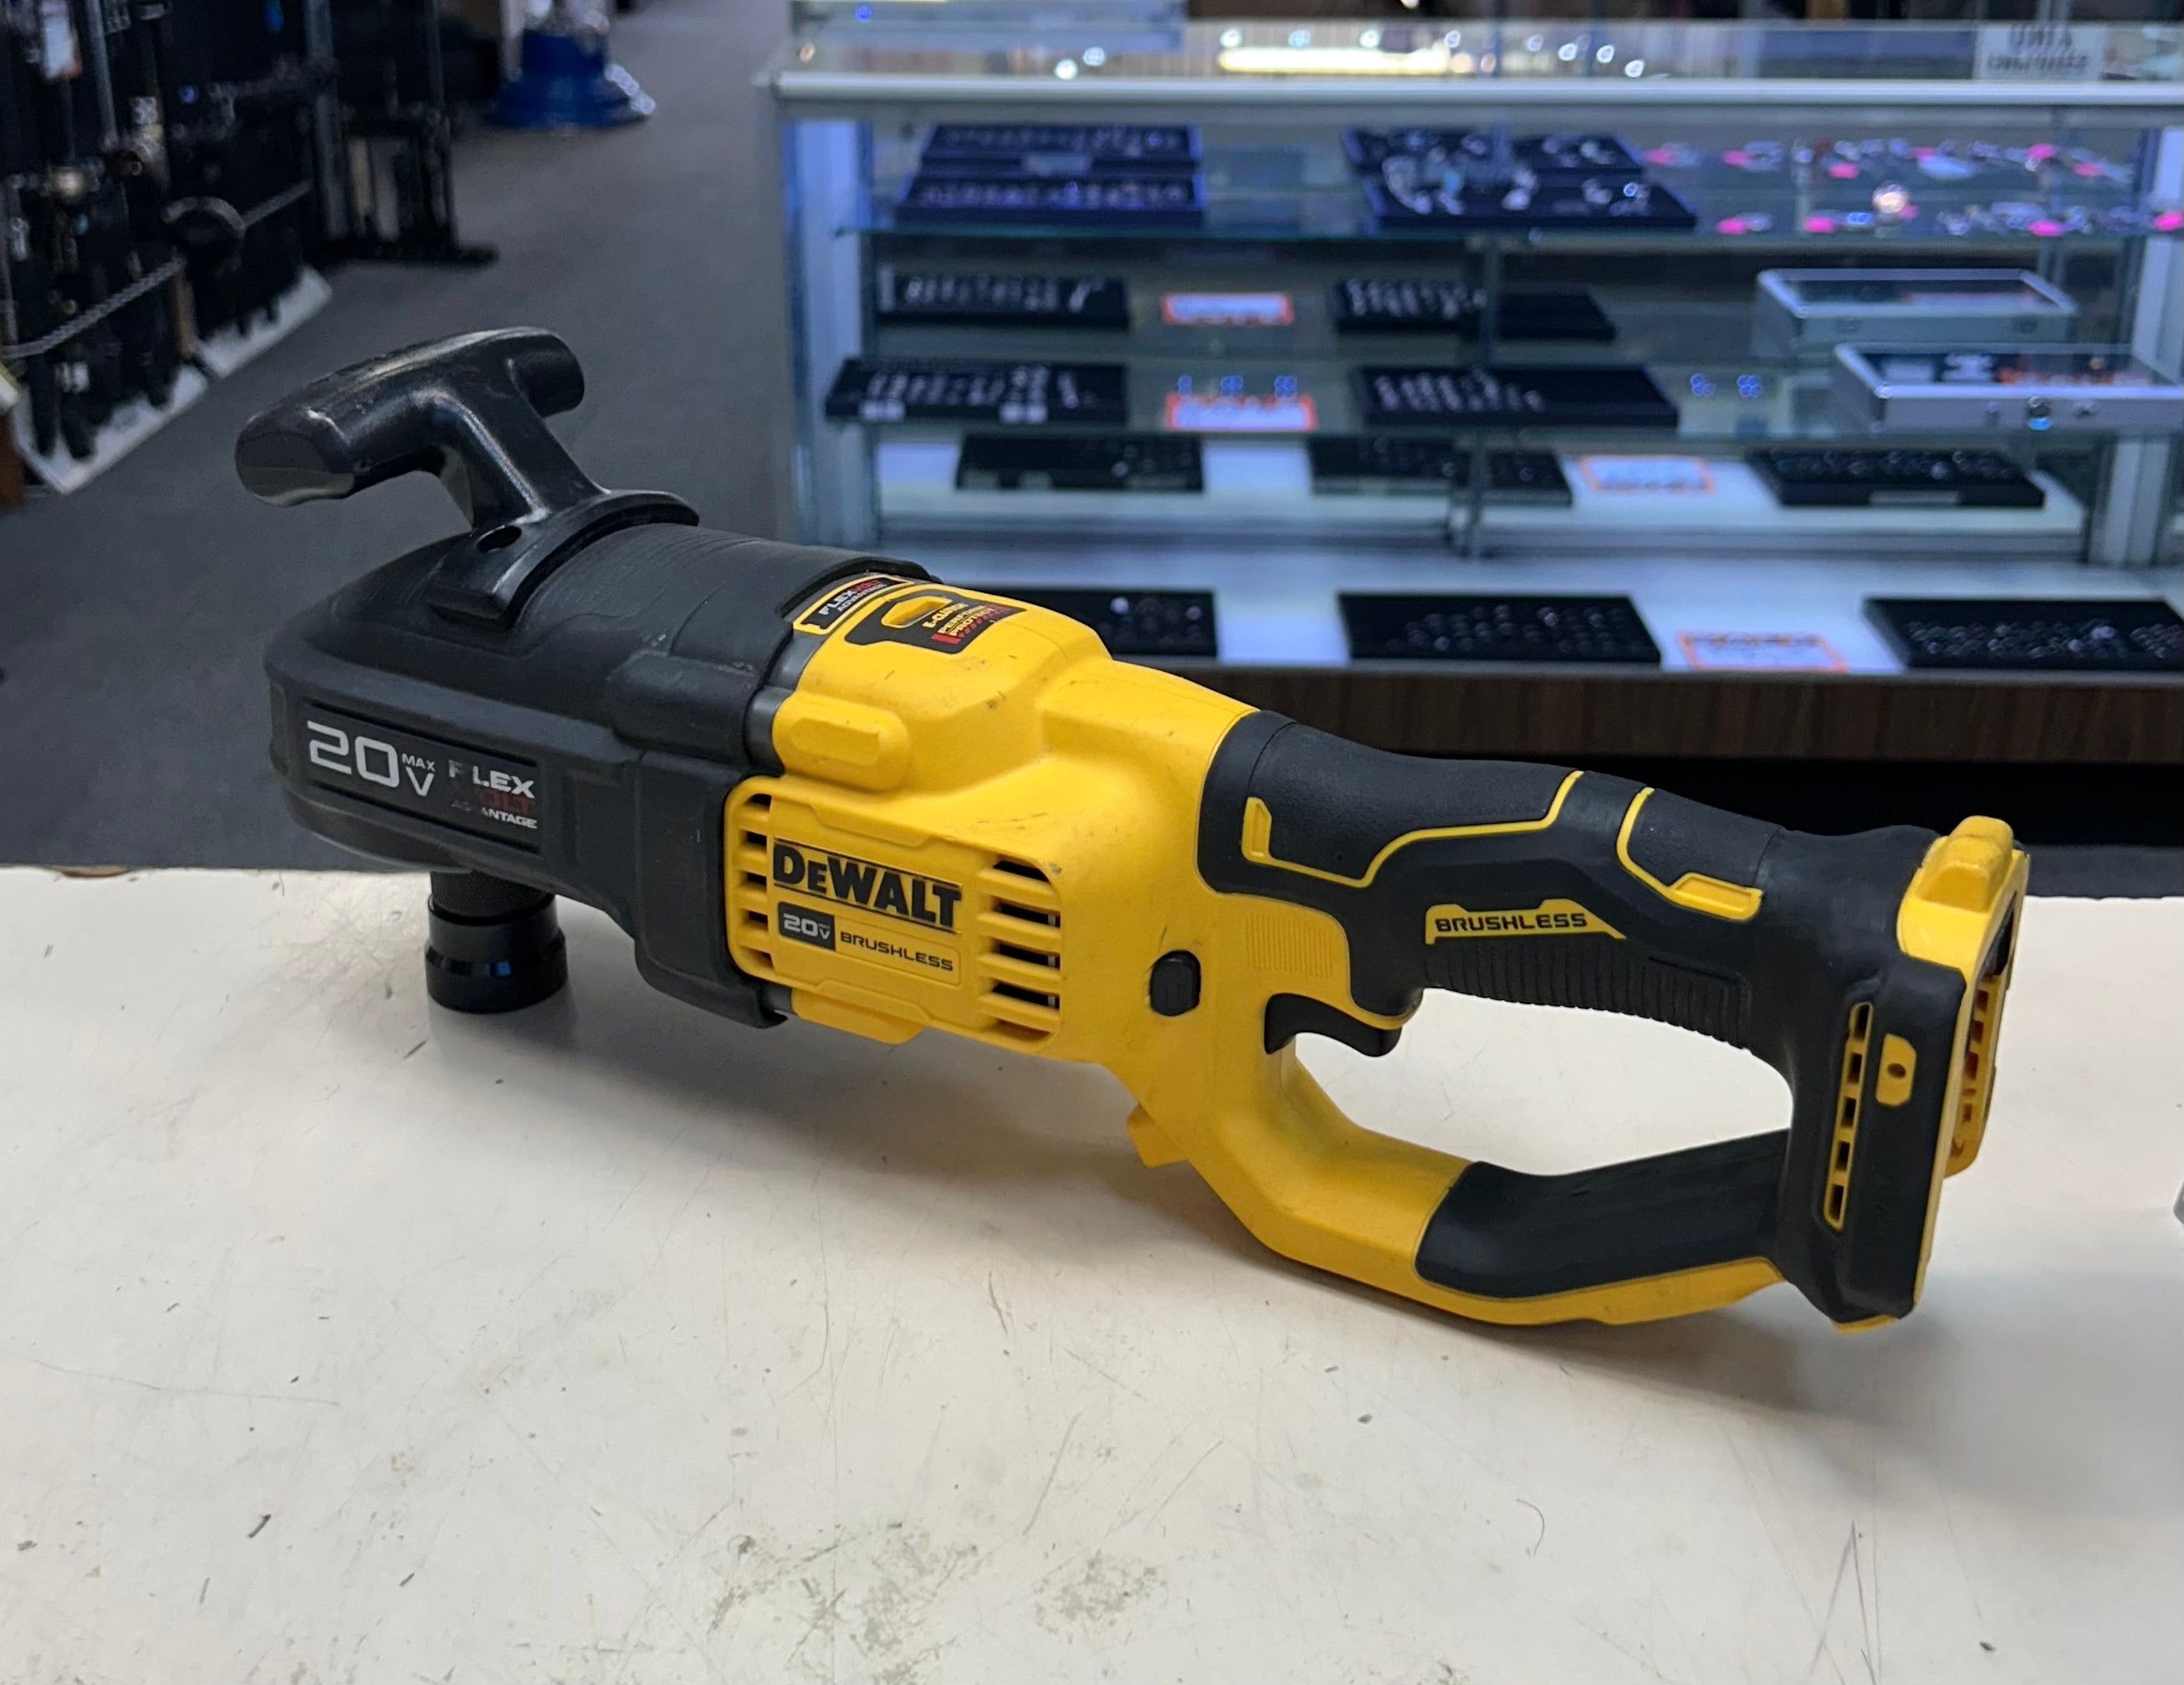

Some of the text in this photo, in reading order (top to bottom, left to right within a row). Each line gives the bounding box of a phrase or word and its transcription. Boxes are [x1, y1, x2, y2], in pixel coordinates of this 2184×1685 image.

[402, 753, 435, 771] MAX
[448, 760, 535, 799] FLEX
[1435, 913, 1588, 932] BRUSHLESS
[840, 931, 953, 971] BRUSHLESS
